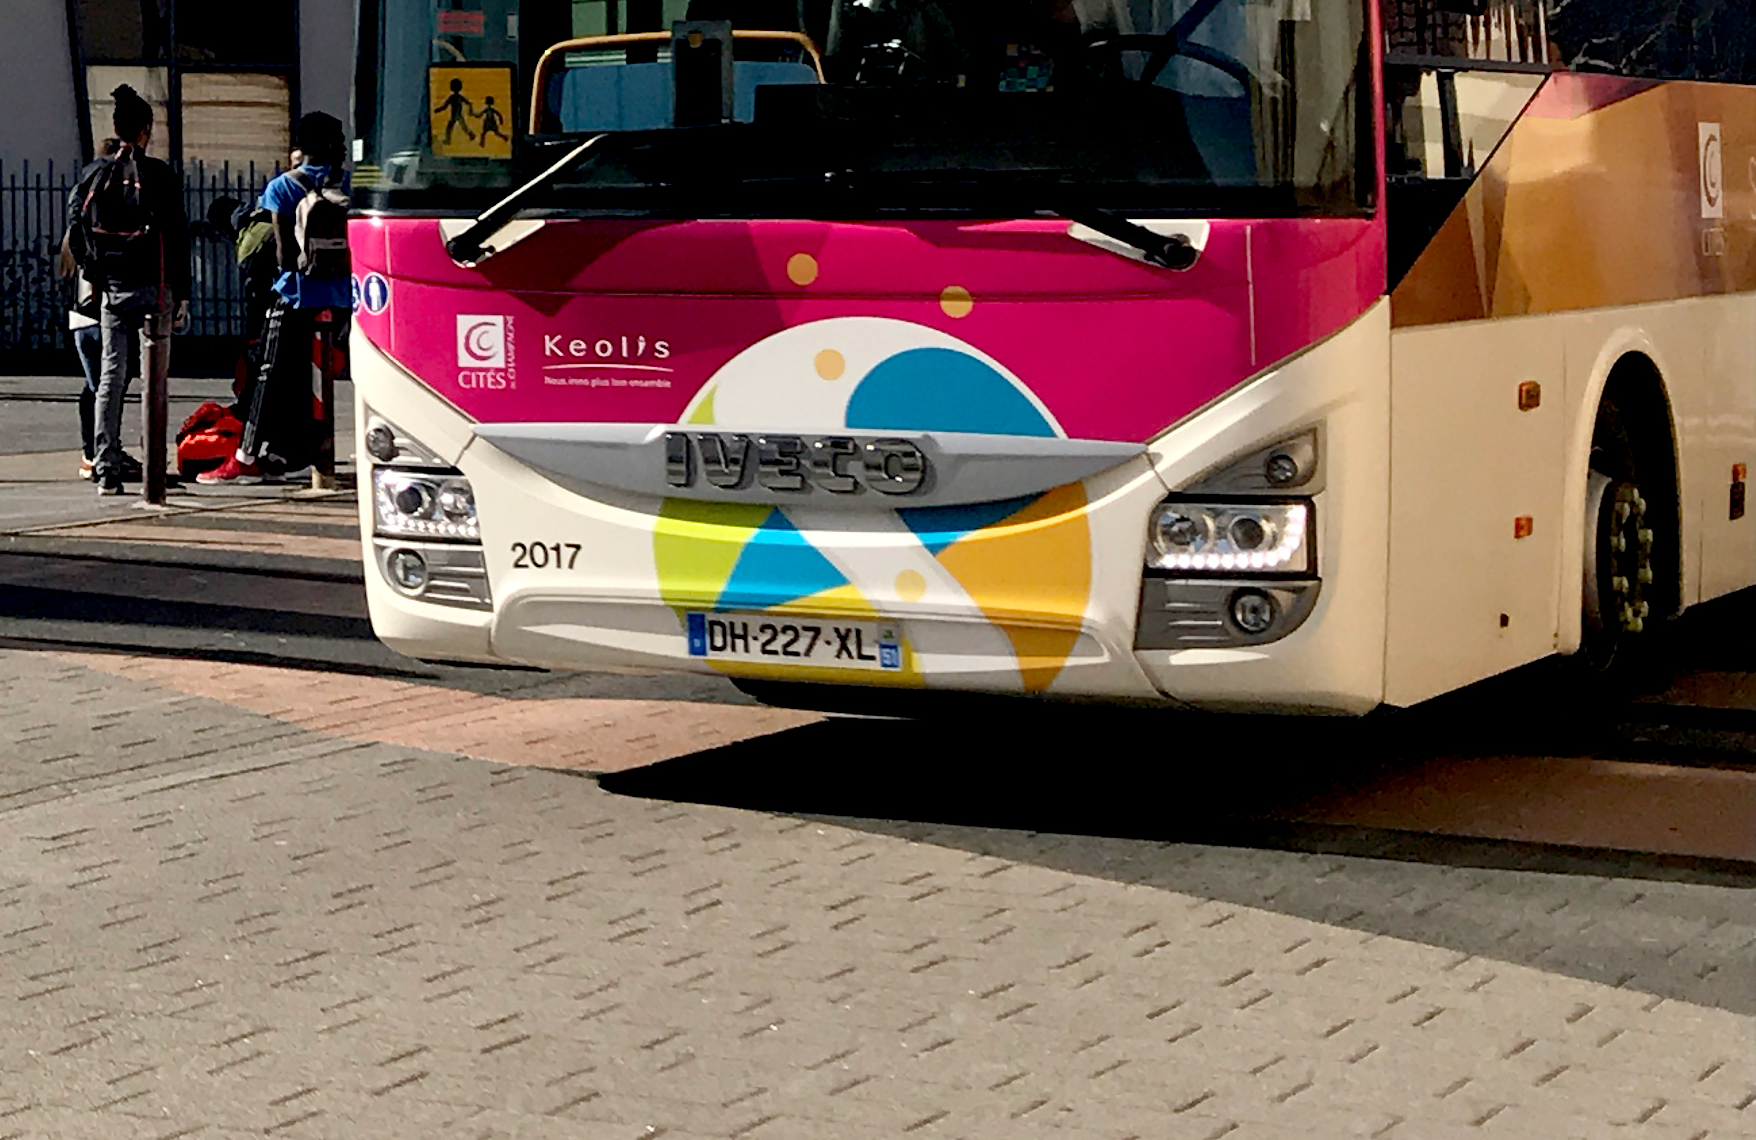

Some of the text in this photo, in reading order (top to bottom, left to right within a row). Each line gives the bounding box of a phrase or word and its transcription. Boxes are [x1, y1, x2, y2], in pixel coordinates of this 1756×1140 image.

[544, 334, 671, 359] Keolis
[457, 368, 507, 390] CITÉS
[665, 432, 928, 496] IVECO
[510, 541, 583, 570] 2017
[708, 620, 877, 661] DH-227-XL
